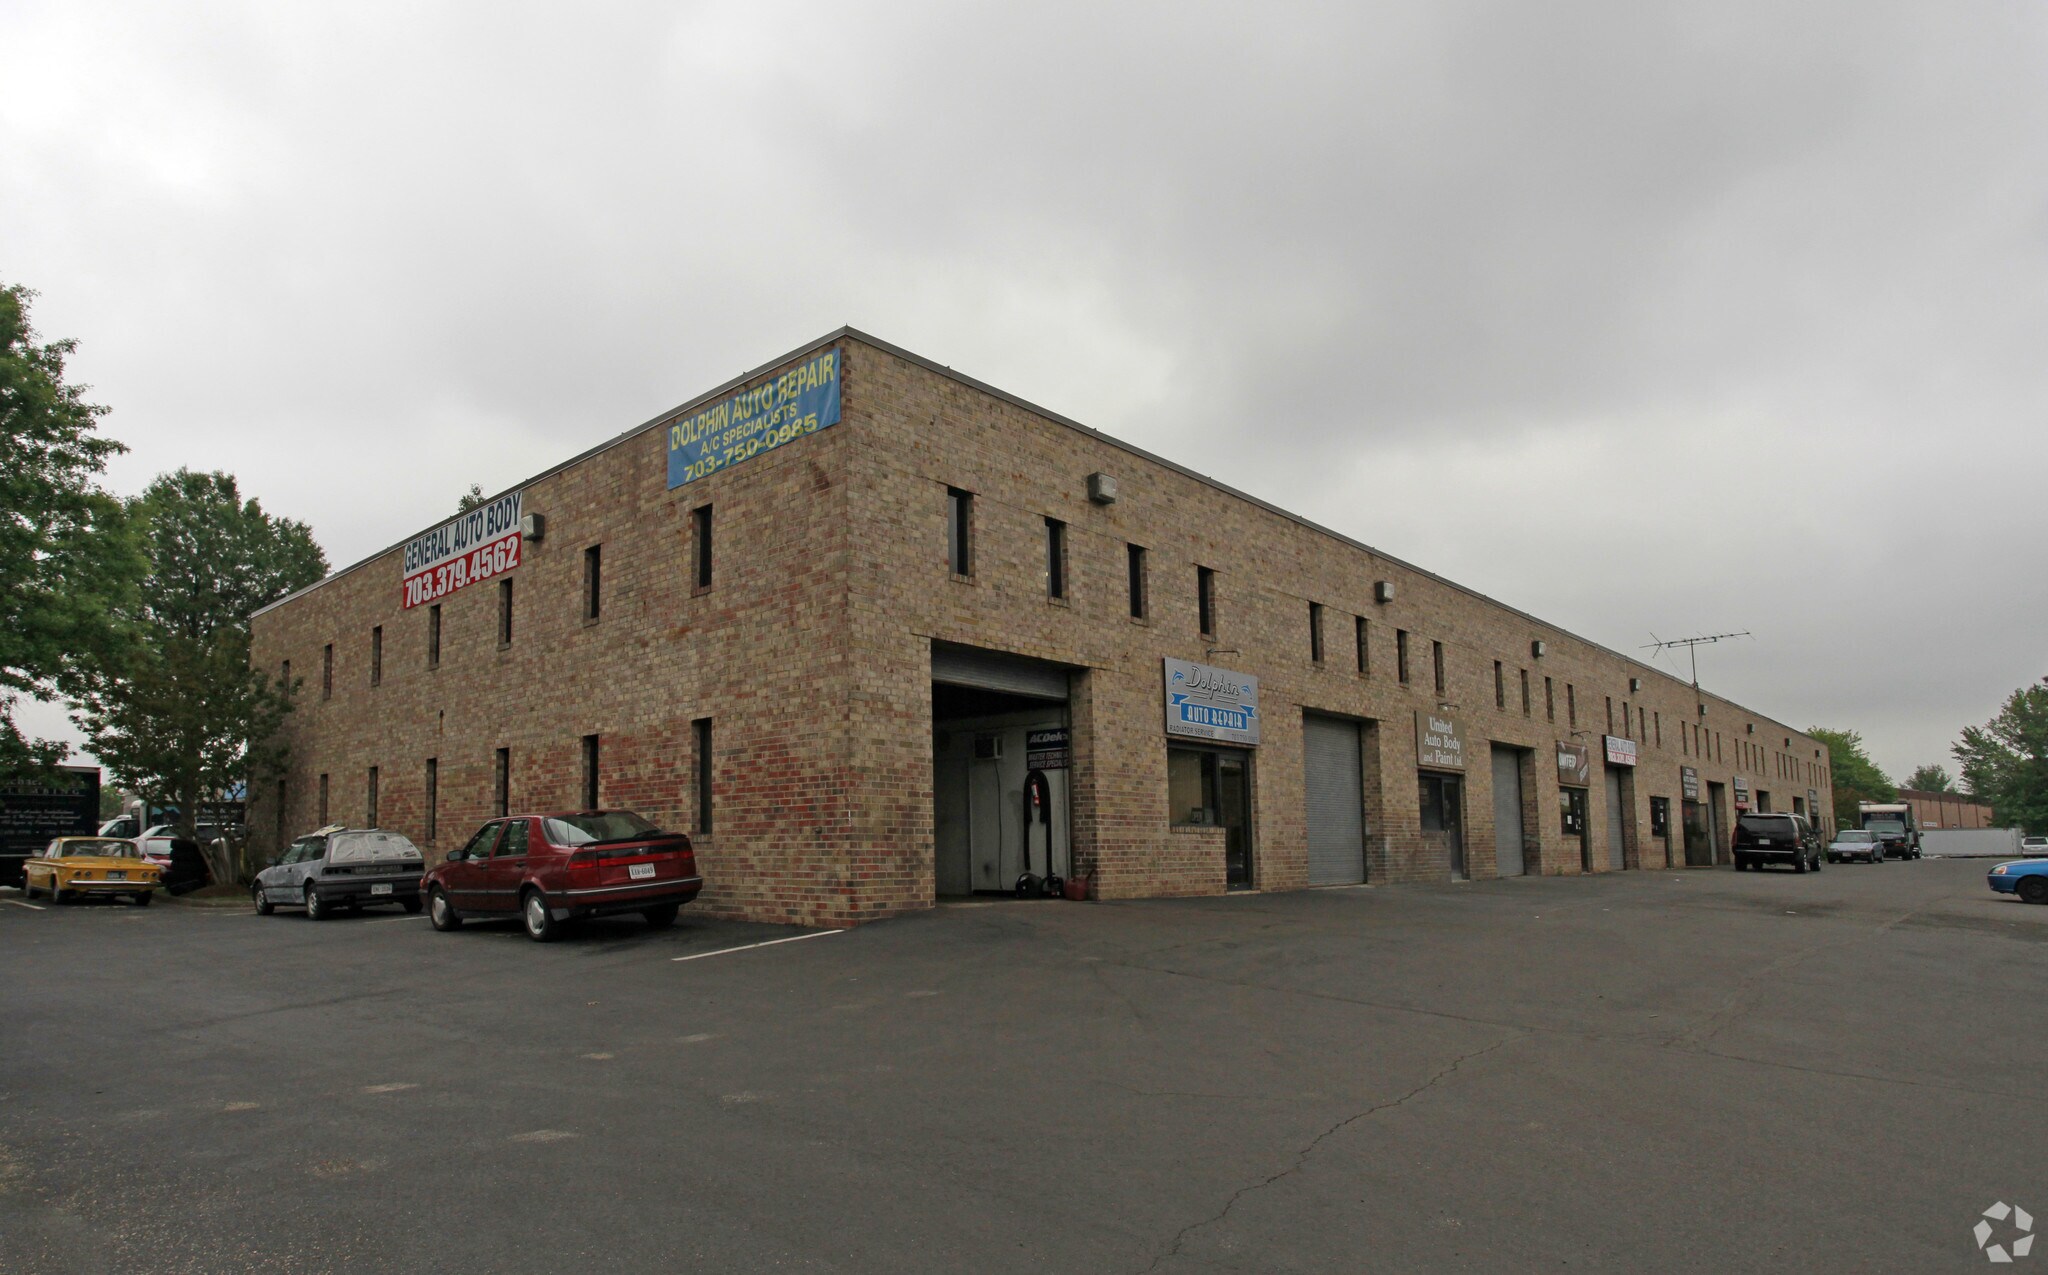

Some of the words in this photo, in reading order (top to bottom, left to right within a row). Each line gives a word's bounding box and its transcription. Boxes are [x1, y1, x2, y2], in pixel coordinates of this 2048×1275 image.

[671, 401, 729, 451] DOLPHIN
[731, 382, 773, 424] AUTO
[777, 353, 834, 403] REPAIR
[700, 434, 720, 456] A/C
[722, 401, 797, 447] SPECIALISTS
[683, 412, 817, 482] 703-750-0985
[405, 526, 450, 573] GENERAL
[453, 510, 483, 552] AUTO
[486, 492, 522, 538] BODY
[405, 535, 518, 608] 703.379.4562
[1186, 665, 1240, 700] Dolphin
[1169, 724, 1194, 734] RADIATOR
[1194, 727, 1214, 737] SERVICE
[1187, 705, 1209, 723] AUTO
[1211, 708, 1243, 729] REPAIR
[1429, 717, 1453, 734] United
[1423, 752, 1433, 762] and
[1435, 750, 1454, 765] Paint
[1424, 732, 1442, 747] Auto
[1443, 734, 1460, 754] Body
